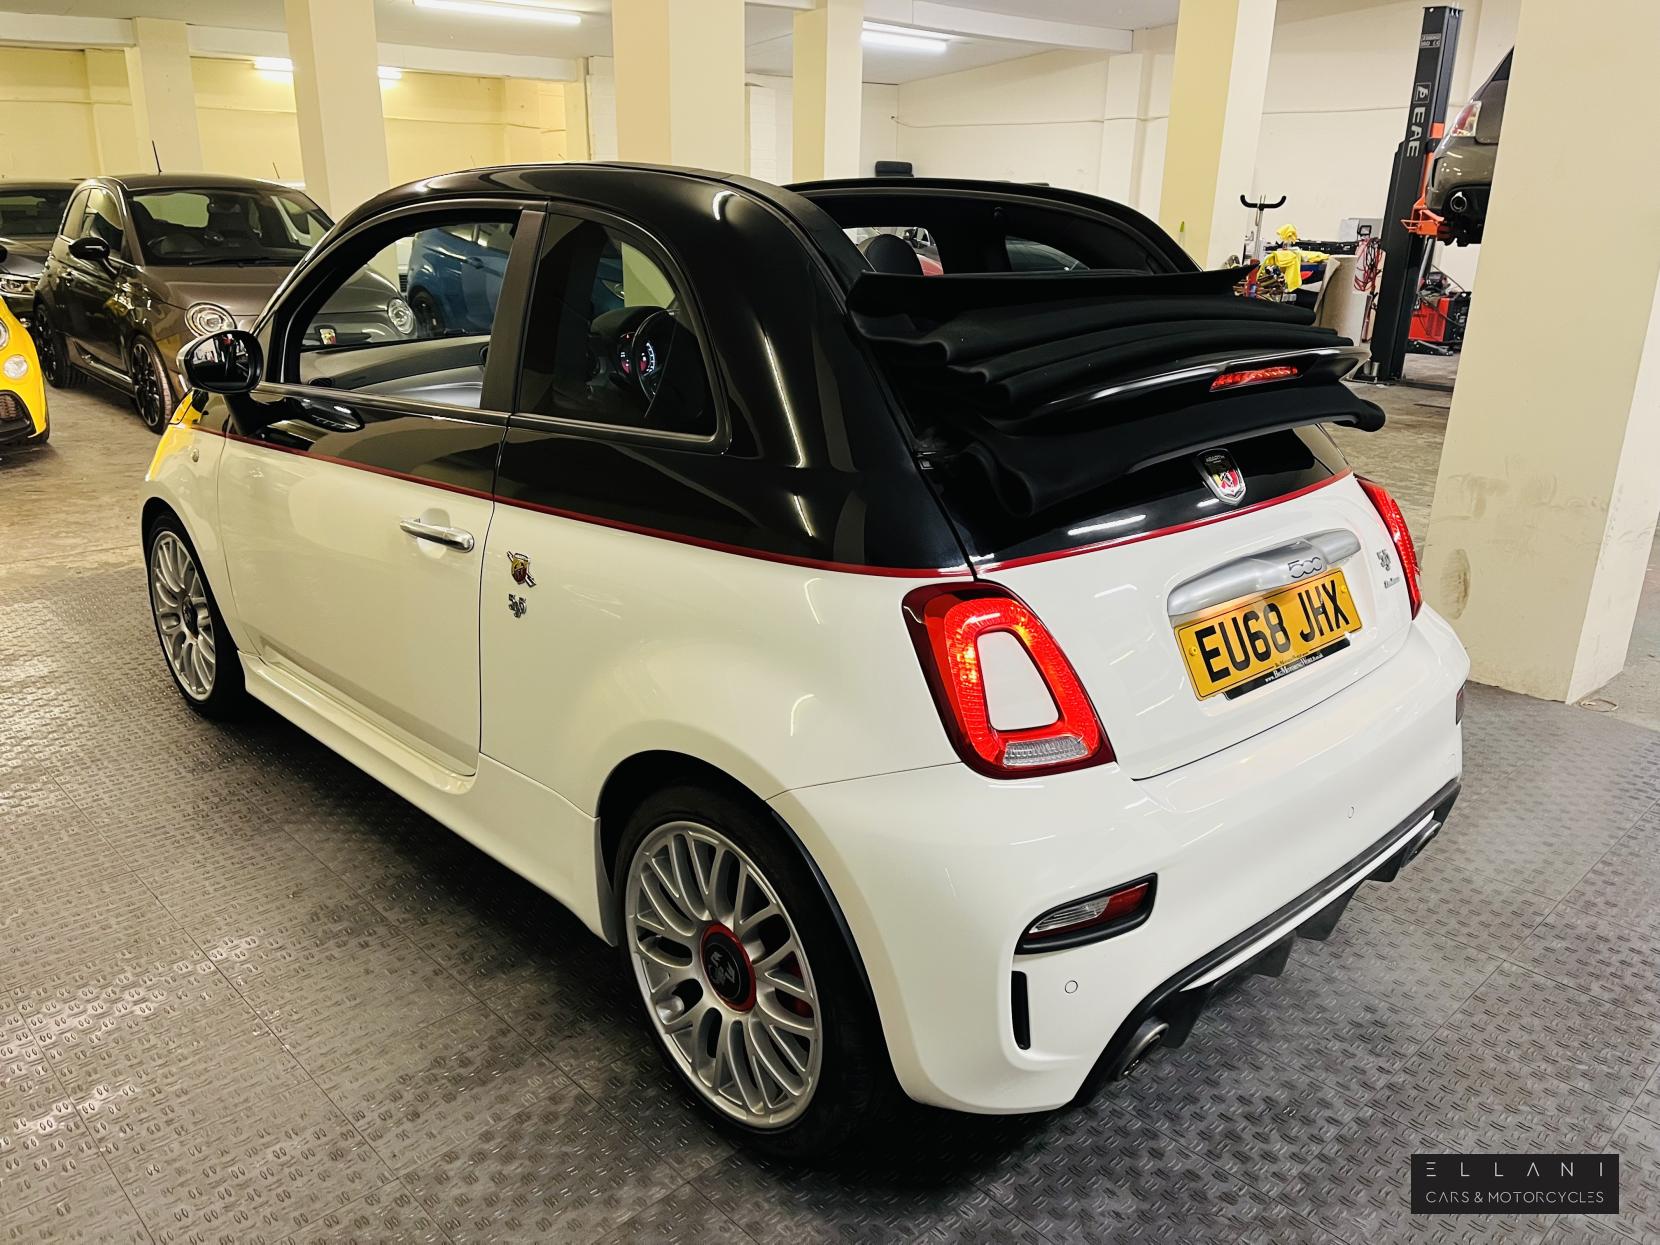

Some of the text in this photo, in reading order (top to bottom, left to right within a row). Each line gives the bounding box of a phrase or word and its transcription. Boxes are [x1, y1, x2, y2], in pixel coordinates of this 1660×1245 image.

[1407, 106, 1426, 157] EAE
[1287, 556, 1323, 579] 500
[1194, 579, 1350, 683] EU68 JHX
